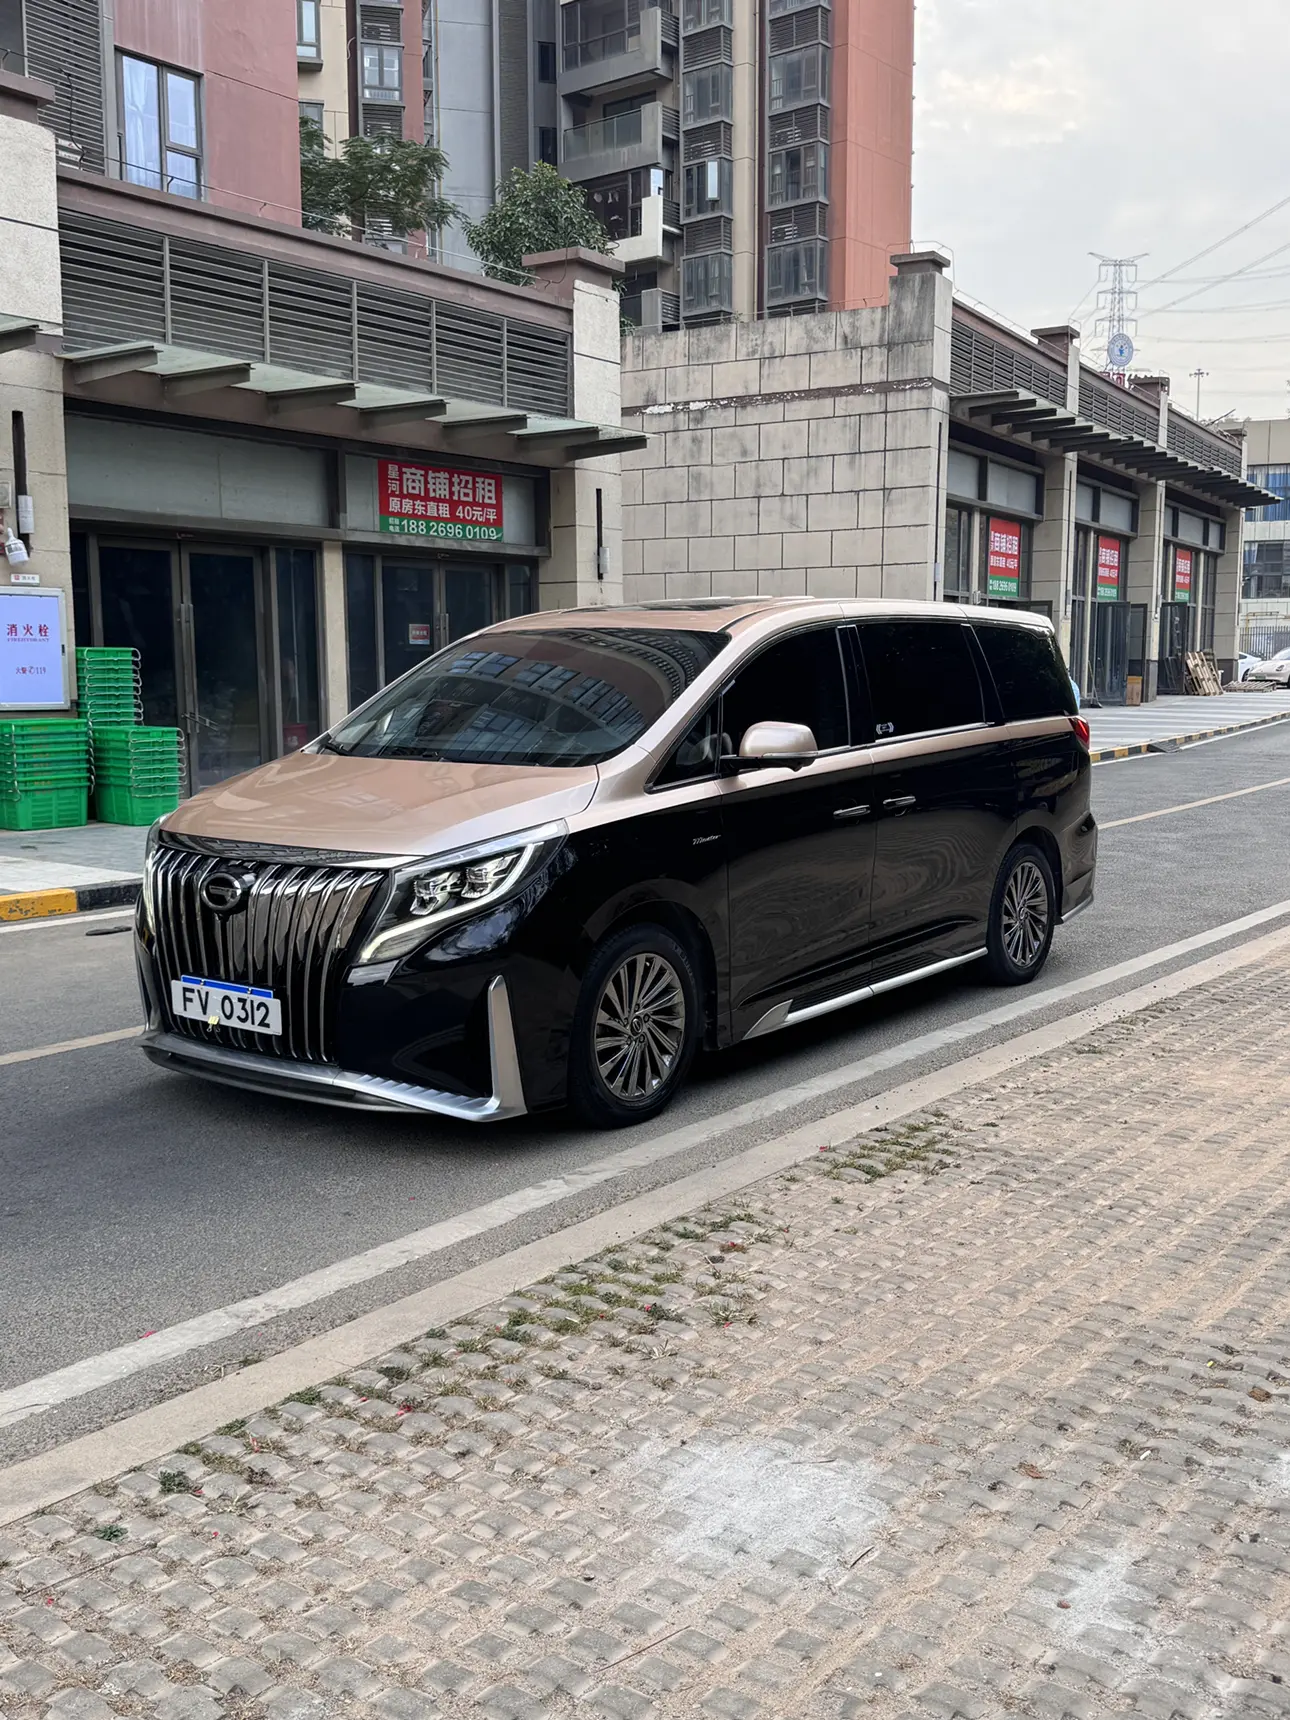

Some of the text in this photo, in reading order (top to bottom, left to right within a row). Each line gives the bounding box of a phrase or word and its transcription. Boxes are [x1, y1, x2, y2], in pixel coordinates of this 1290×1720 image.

[388, 463, 400, 495] 星河
[402, 467, 497, 505] 商铺招租
[388, 497, 498, 523] 原房东直租 40元/平
[401, 519, 498, 540] 188 2696 0109
[7, 623, 49, 637] 消火栓
[36, 666, 47, 675] 119
[182, 986, 271, 1029] FV 0312
